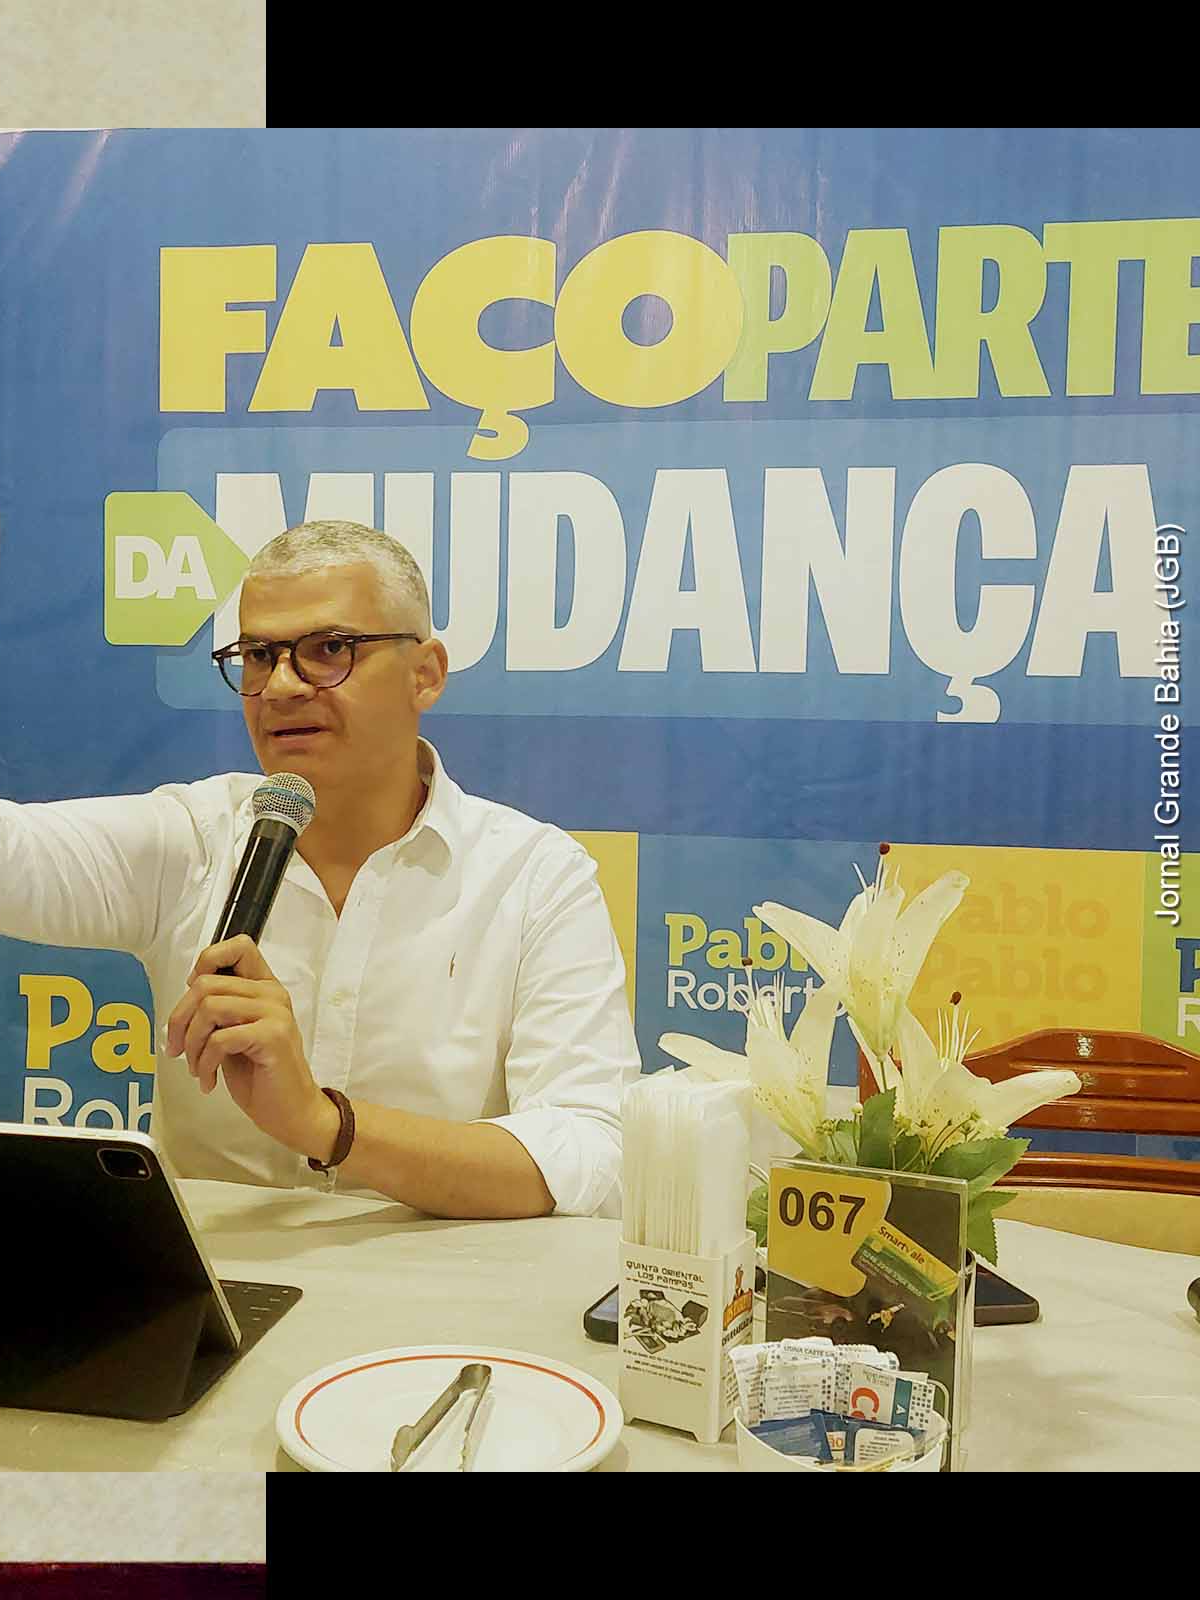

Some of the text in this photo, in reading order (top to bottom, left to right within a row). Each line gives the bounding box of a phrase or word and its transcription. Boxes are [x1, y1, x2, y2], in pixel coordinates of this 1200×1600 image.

[159, 218, 1200, 461] FAÇO PARTE
[114, 534, 217, 601] DA
[779, 1186, 866, 1235] 067
